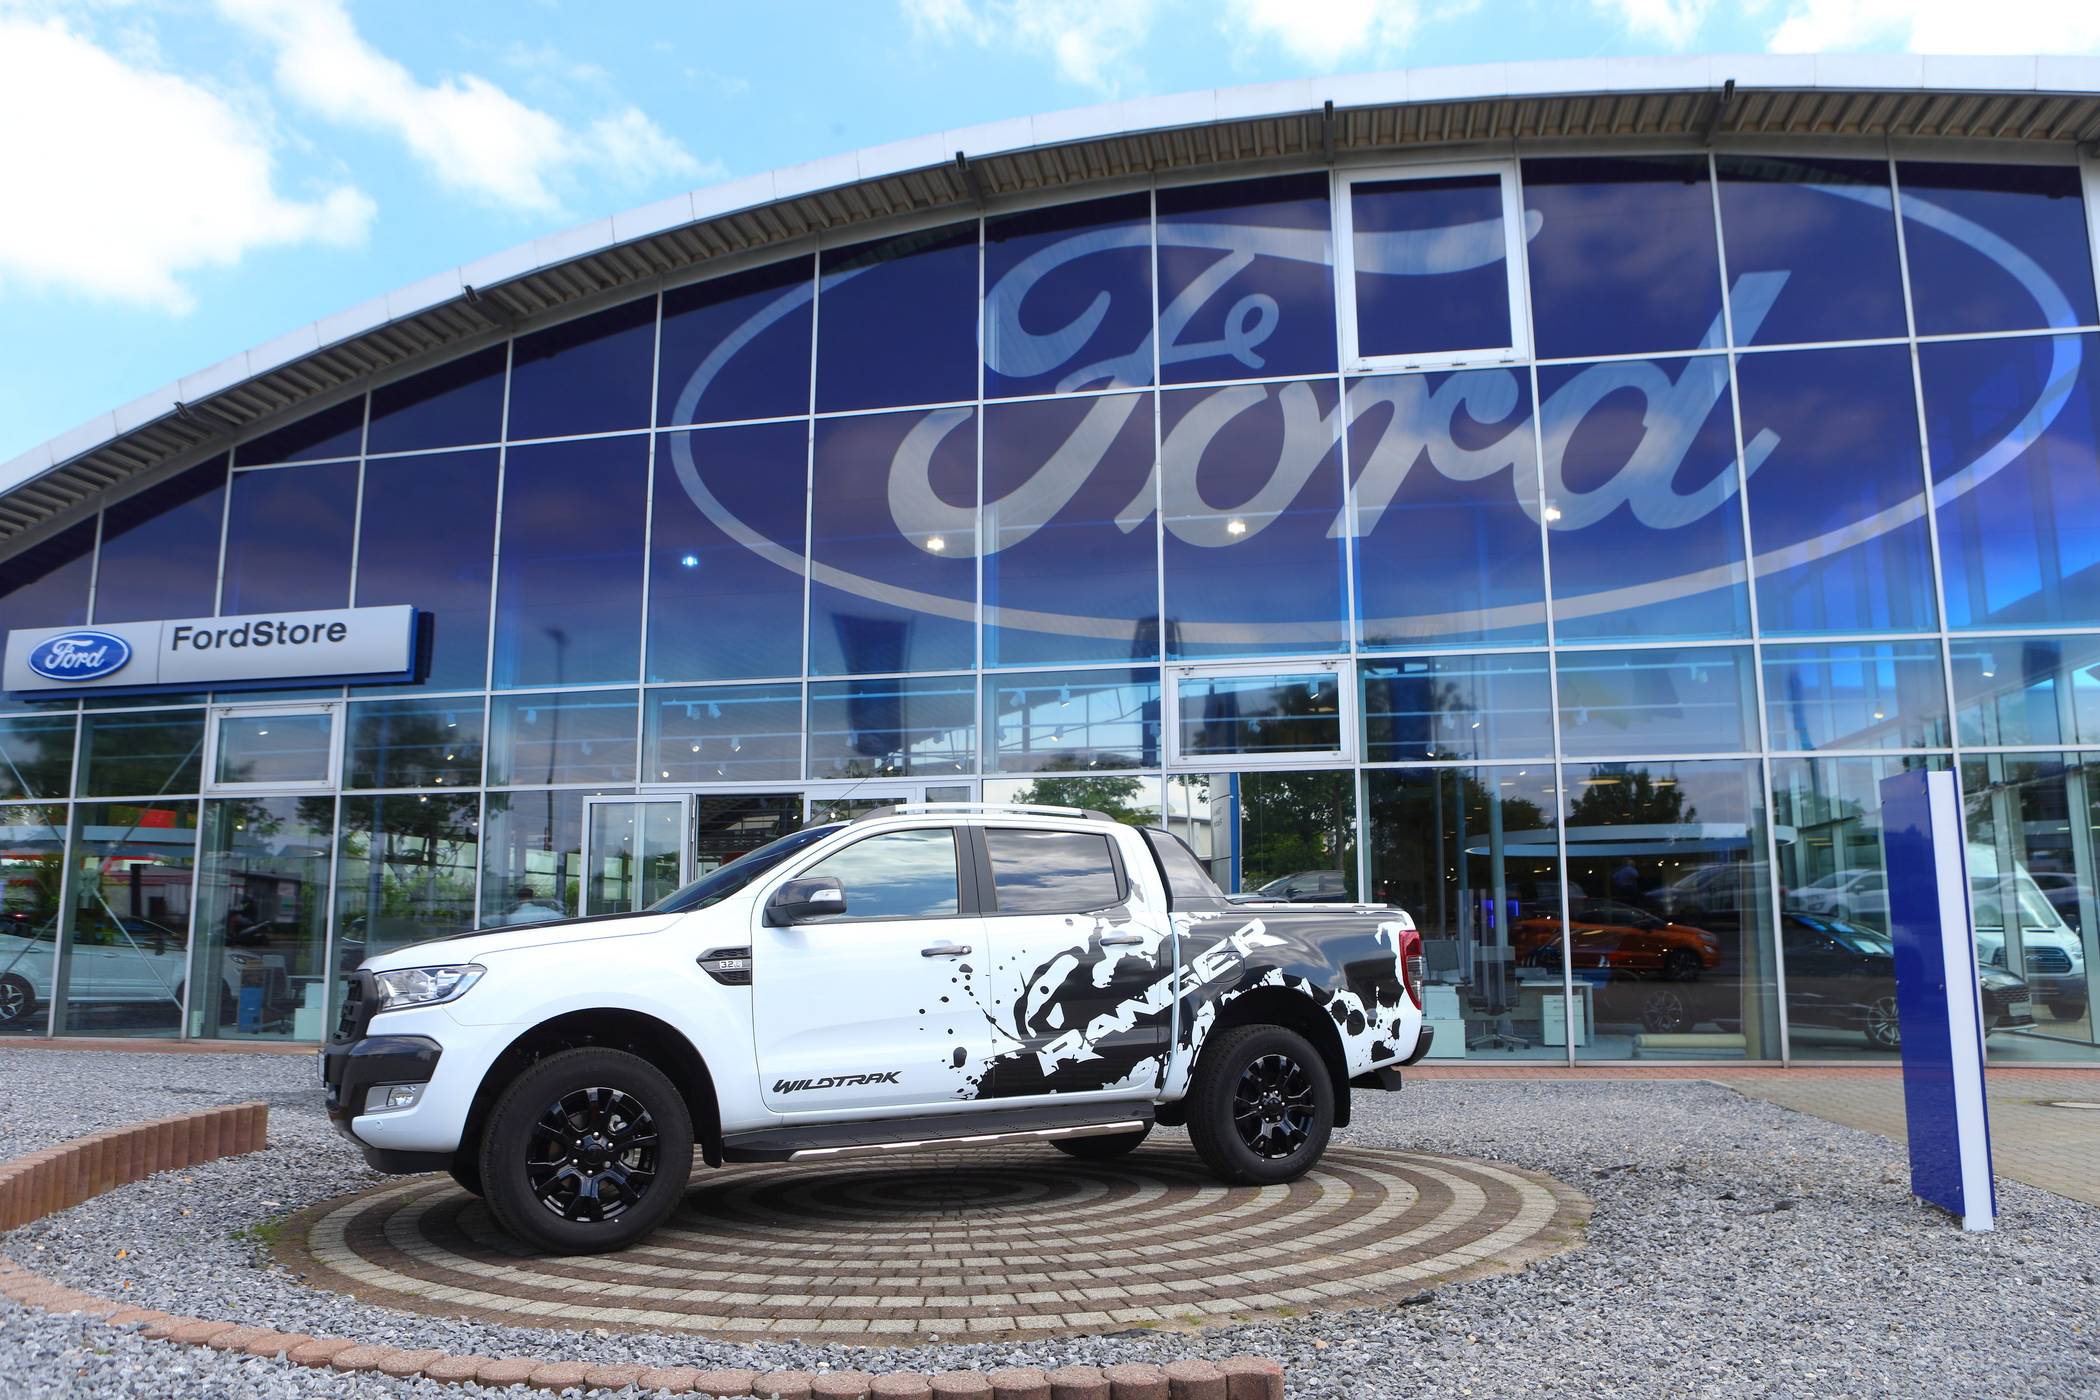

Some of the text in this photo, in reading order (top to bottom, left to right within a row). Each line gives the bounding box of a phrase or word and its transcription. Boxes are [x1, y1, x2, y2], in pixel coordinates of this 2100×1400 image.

[888, 208, 1792, 559] Ford
[44, 620, 347, 669] Ford FordStore
[1036, 918, 1288, 1077] RANGER
[772, 1071, 902, 1094] WILDTRAK
